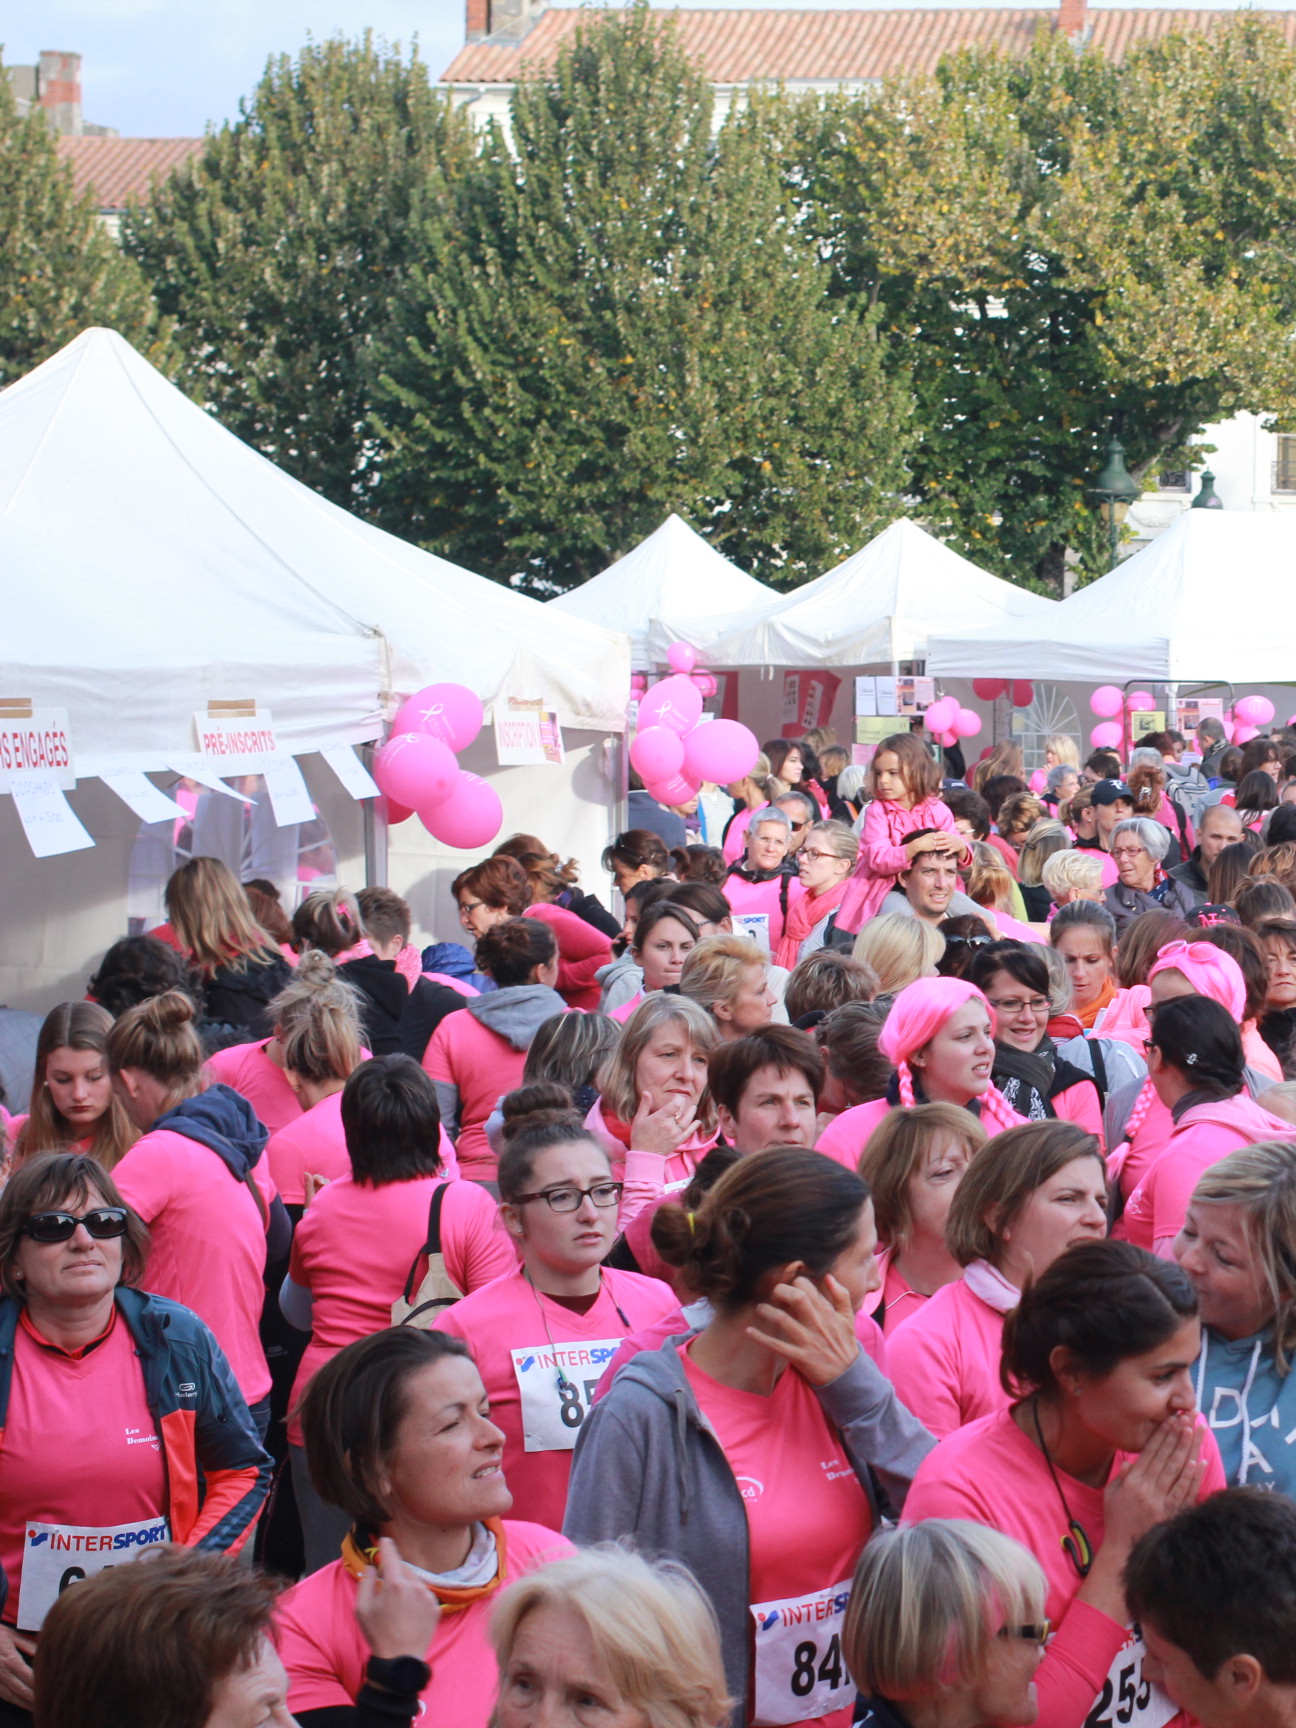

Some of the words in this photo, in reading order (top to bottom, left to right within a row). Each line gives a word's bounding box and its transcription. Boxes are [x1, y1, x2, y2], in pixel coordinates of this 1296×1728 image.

[12, 721, 69, 769] ENGAGÉS
[203, 727, 276, 756] PRÉ-INSCRITS
[125, 1427, 140, 1435] Les
[50, 1524, 167, 1552] INTERSPORT
[791, 1632, 850, 1697] 84
